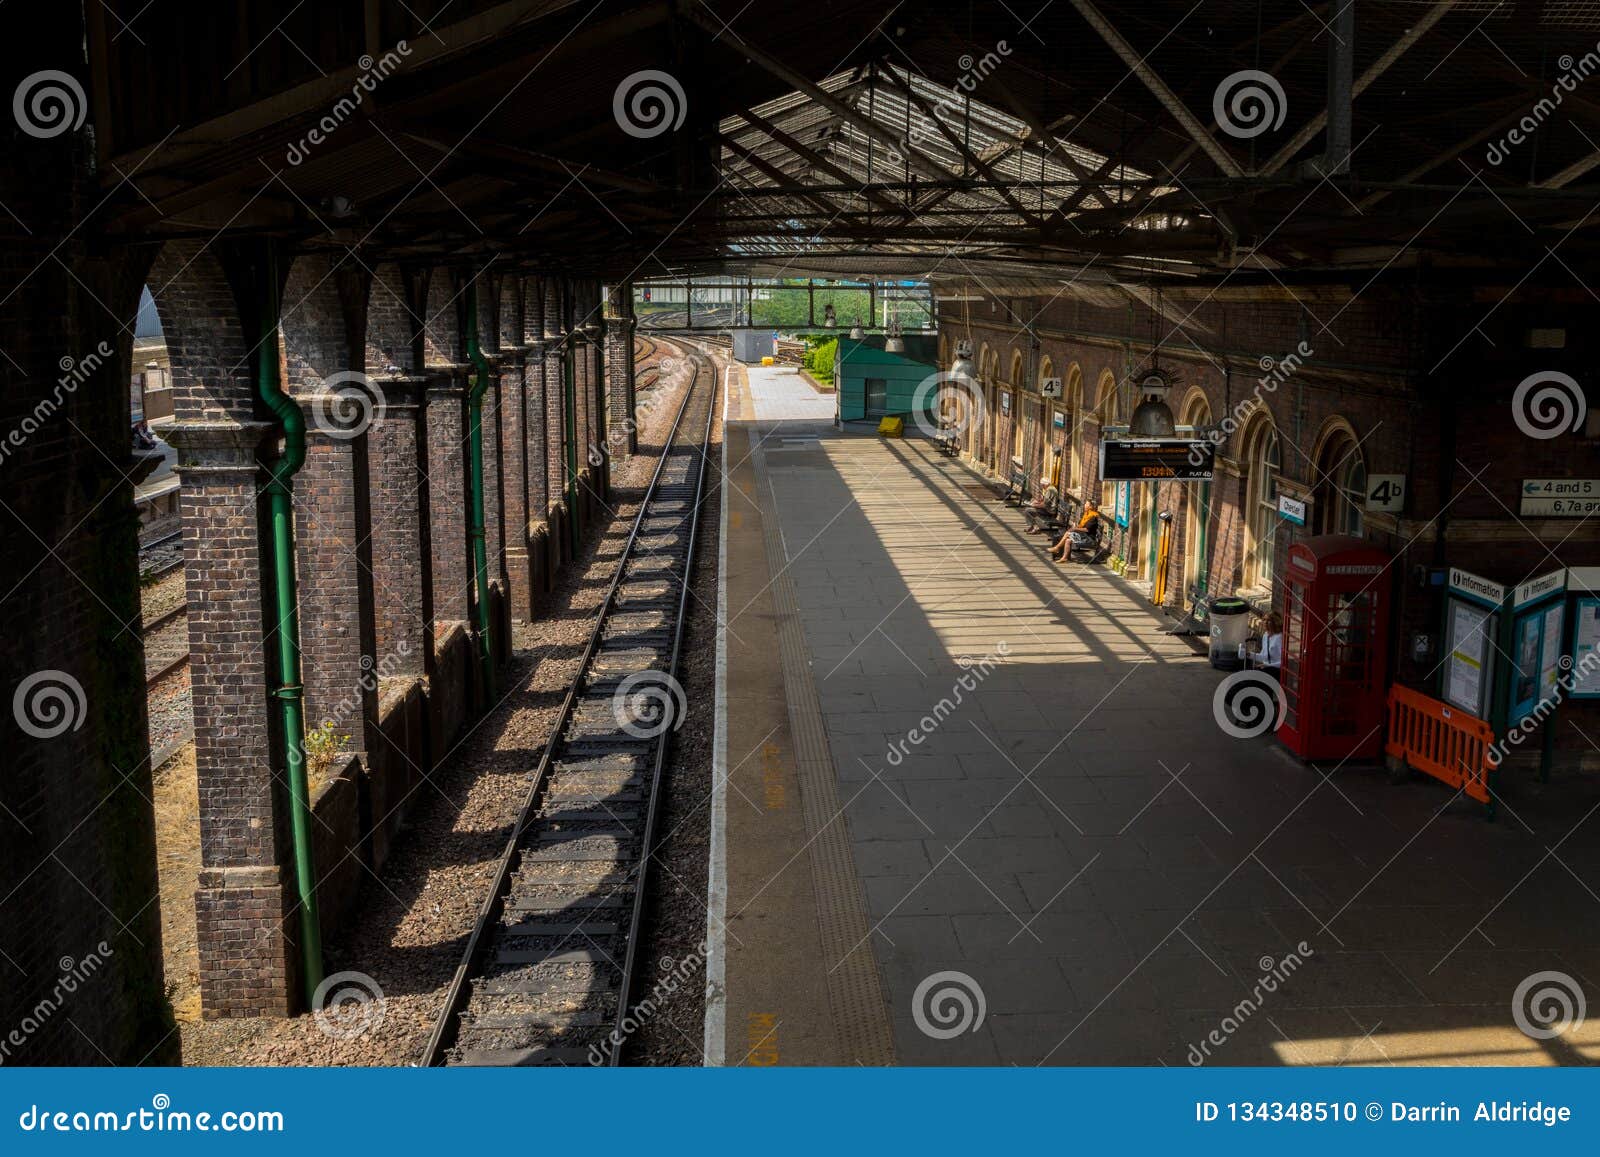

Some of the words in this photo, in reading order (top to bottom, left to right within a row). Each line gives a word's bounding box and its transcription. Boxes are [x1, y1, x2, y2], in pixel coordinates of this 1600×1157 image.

[1369, 480, 1403, 506] 4b
[1543, 482, 1552, 493] 4
[1556, 481, 1580, 493] and
[1583, 481, 1592, 493] 5
[1461, 574, 1500, 599] Information
